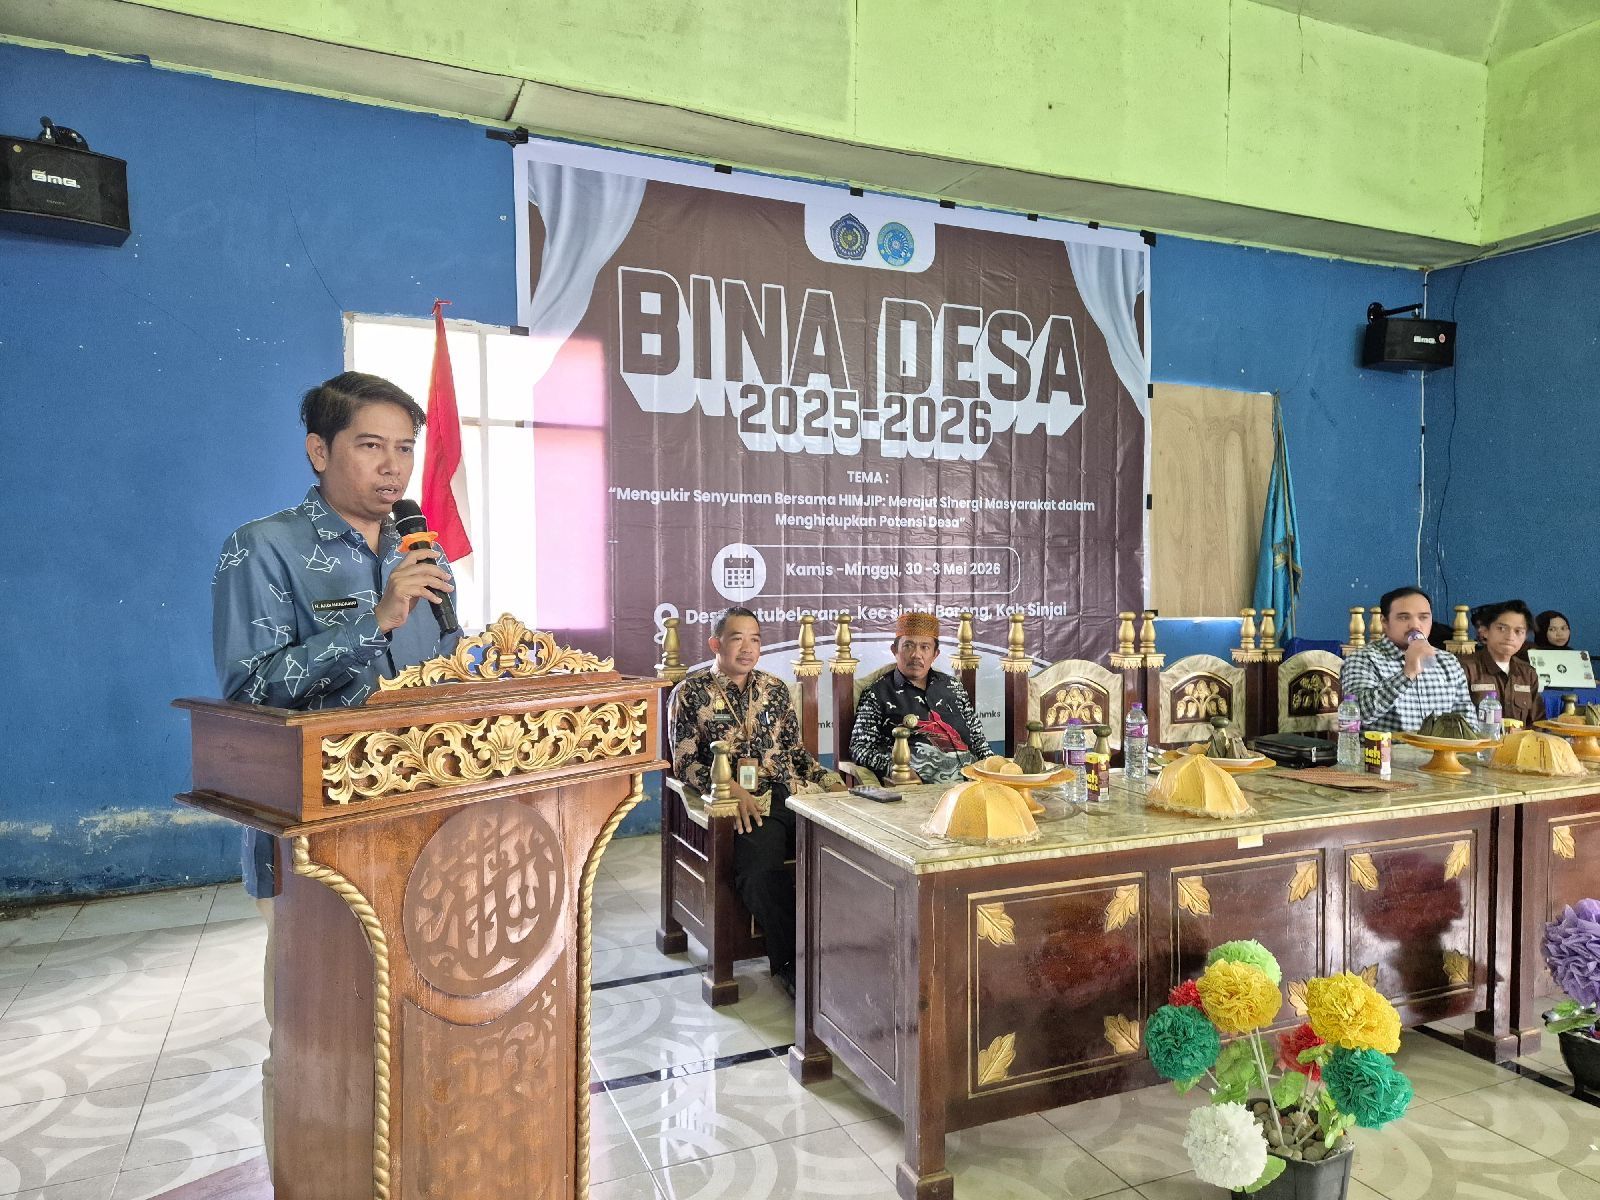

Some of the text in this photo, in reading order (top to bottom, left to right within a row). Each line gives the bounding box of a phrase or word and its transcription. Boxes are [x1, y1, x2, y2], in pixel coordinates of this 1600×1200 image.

[617, 266, 1087, 415] BINA DESA
[738, 384, 993, 452] 2025-2026
[846, 470, 882, 484] TEMA
[693, 489, 772, 506] Senyuman
[774, 492, 836, 506] Bersama
[838, 494, 886, 507] HIMJIP:
[888, 495, 938, 511] Merajut
[939, 496, 983, 513] Sinergi
[984, 498, 1057, 513] Masyarakat
[1058, 499, 1096, 512] dalam
[775, 513, 877, 530] Menghidupkan
[879, 514, 927, 529] Potensi
[785, 562, 834, 577] Kamis
[904, 562, 923, 576] 30
[943, 562, 967, 575] Mei
[969, 562, 1002, 576] 2026
[685, 609, 721, 625] Des
[1027, 601, 1068, 621] Sinjai
